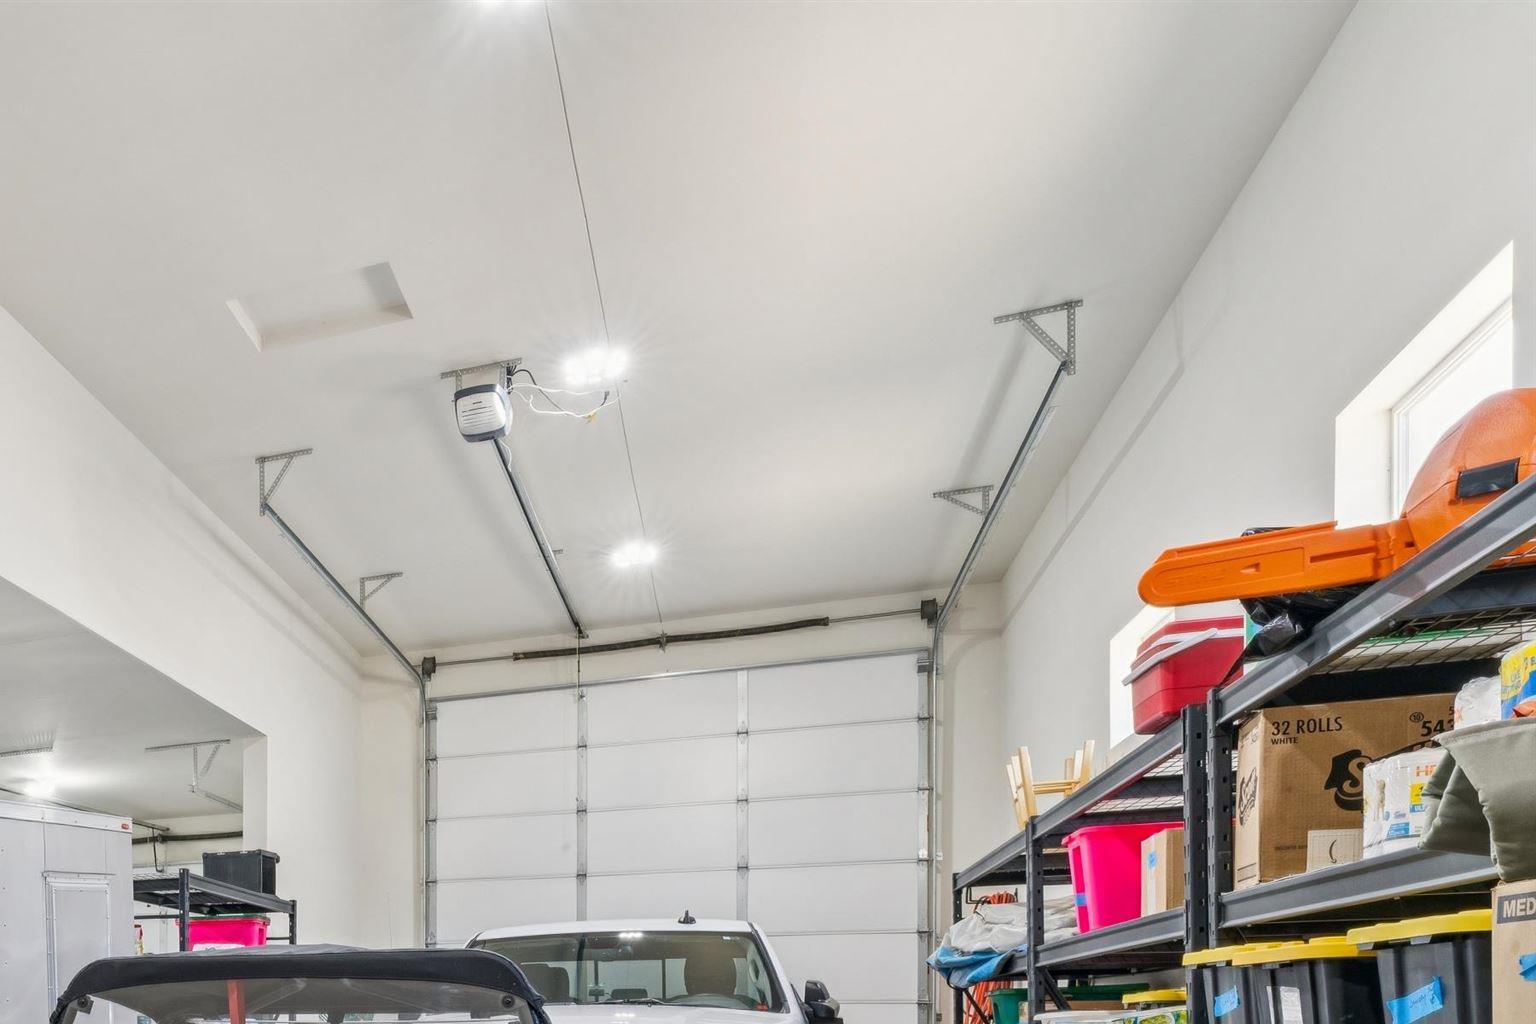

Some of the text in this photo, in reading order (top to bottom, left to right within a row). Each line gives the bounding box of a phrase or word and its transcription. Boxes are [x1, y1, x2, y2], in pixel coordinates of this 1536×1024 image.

[1271, 717, 1343, 736] 32 ROLLS
[1271, 737, 1299, 746] WHITE
